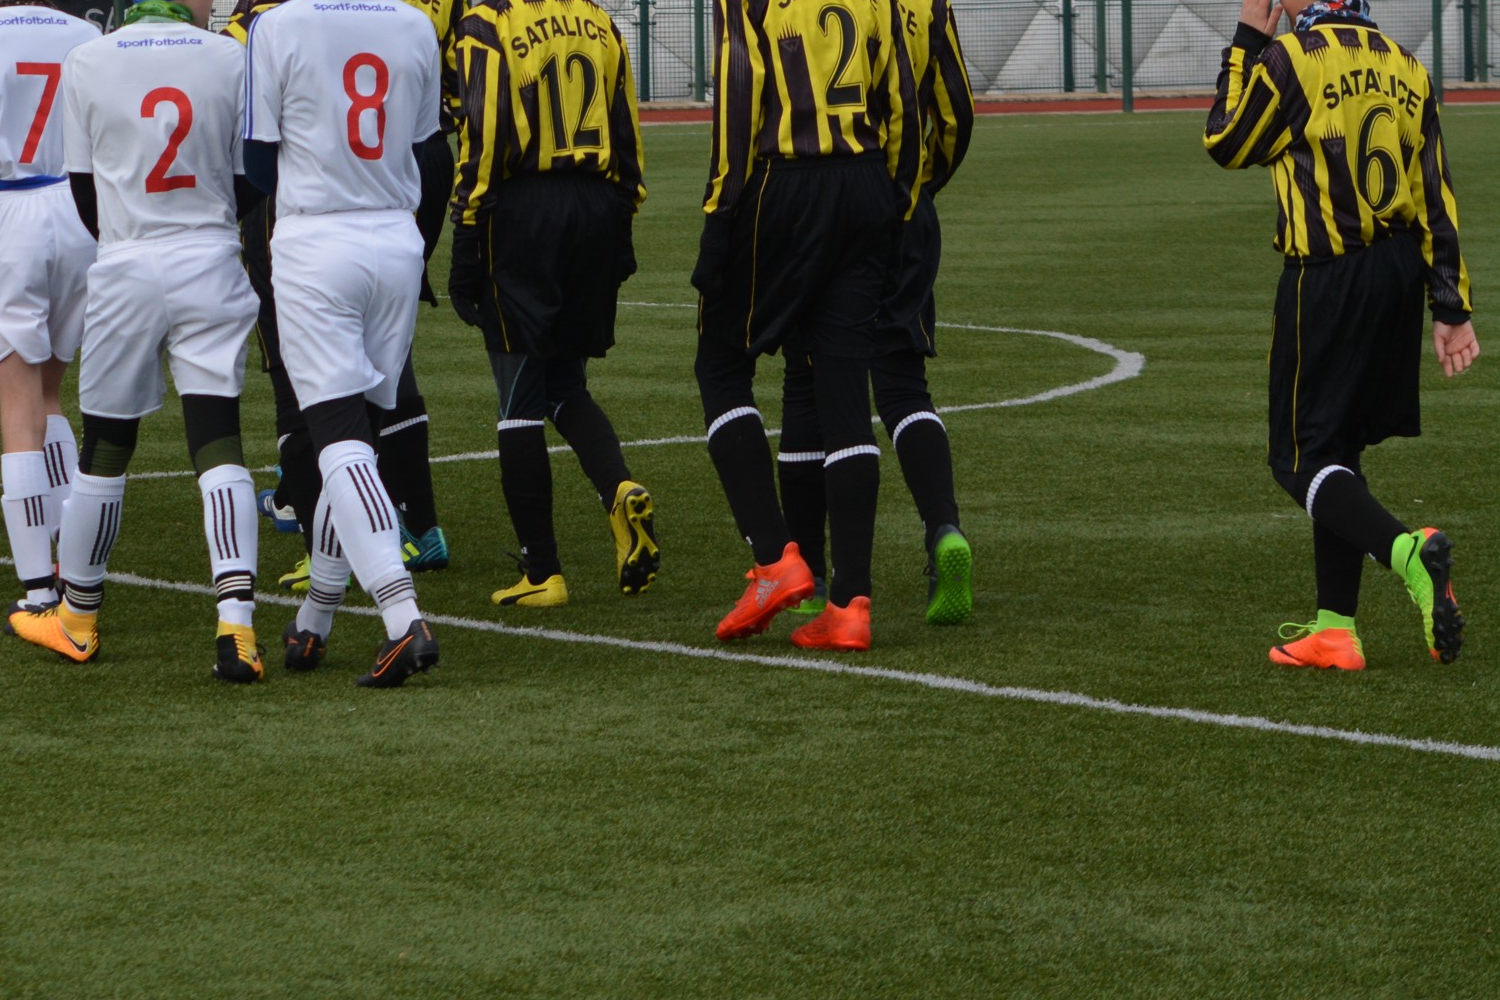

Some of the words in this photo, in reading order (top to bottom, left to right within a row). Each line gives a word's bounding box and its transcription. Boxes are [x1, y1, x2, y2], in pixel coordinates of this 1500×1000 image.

[511, 15, 608, 60] SATALICE
[816, 3, 866, 109] 2
[15, 61, 62, 164] 7
[140, 86, 196, 194] 2
[342, 51, 389, 161] 8
[539, 50, 604, 153] 12
[1355, 103, 1400, 215] 6
